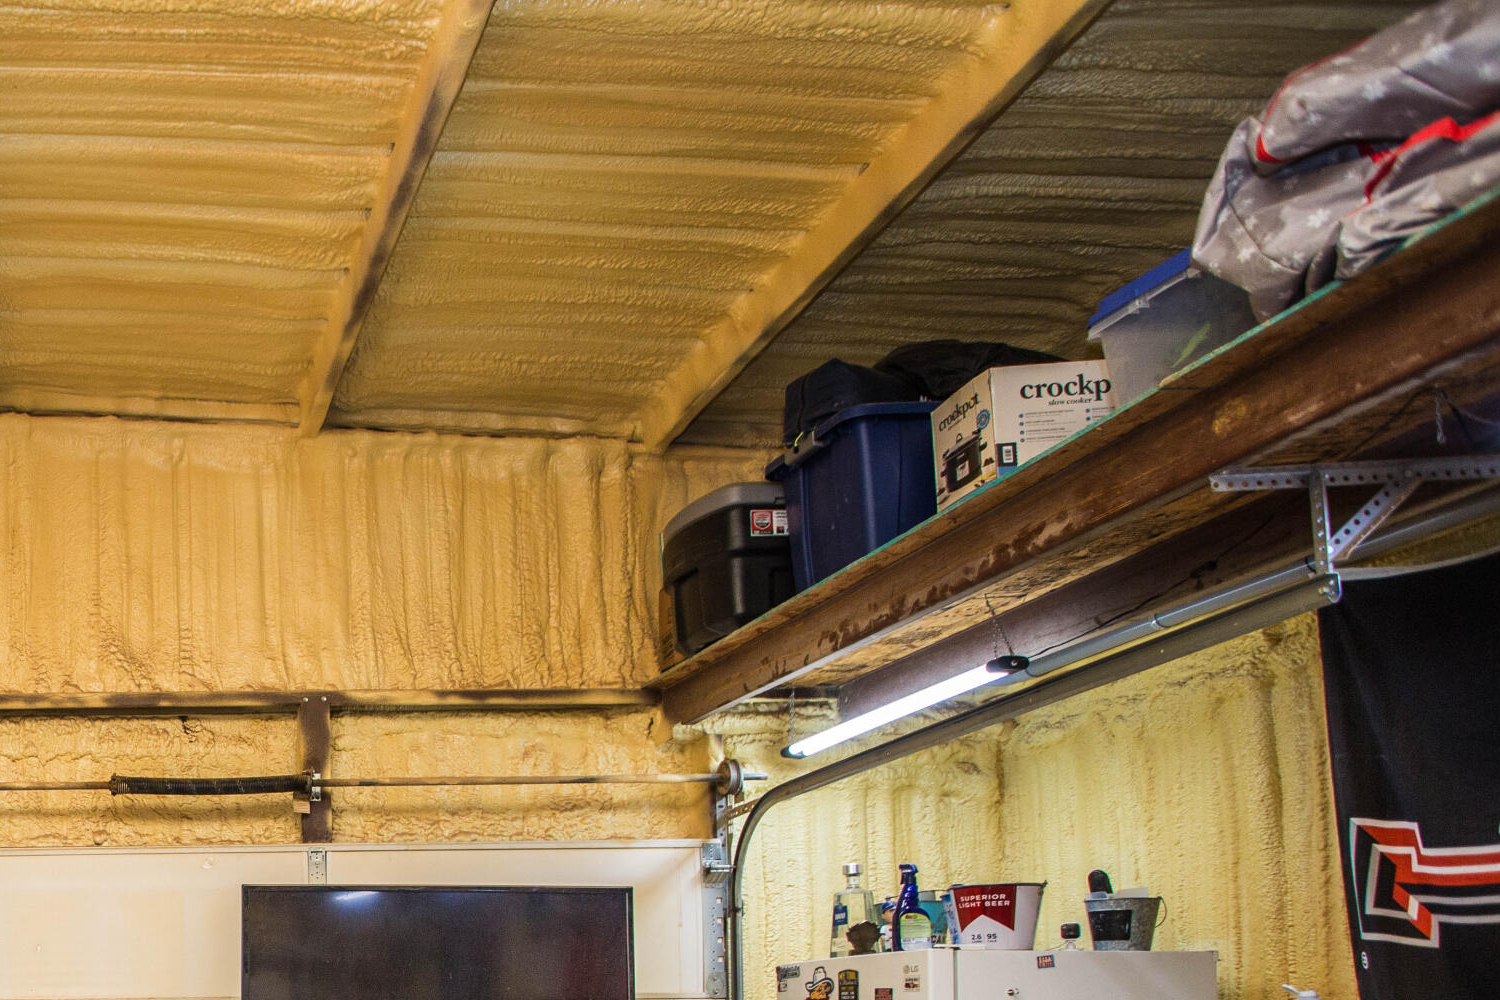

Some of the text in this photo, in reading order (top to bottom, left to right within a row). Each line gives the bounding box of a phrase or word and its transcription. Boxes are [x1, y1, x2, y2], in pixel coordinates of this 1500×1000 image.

[1019, 373, 1112, 402] crockp
[960, 893, 1006, 902] SUPERIOR
[958, 901, 981, 909] LIGHT
